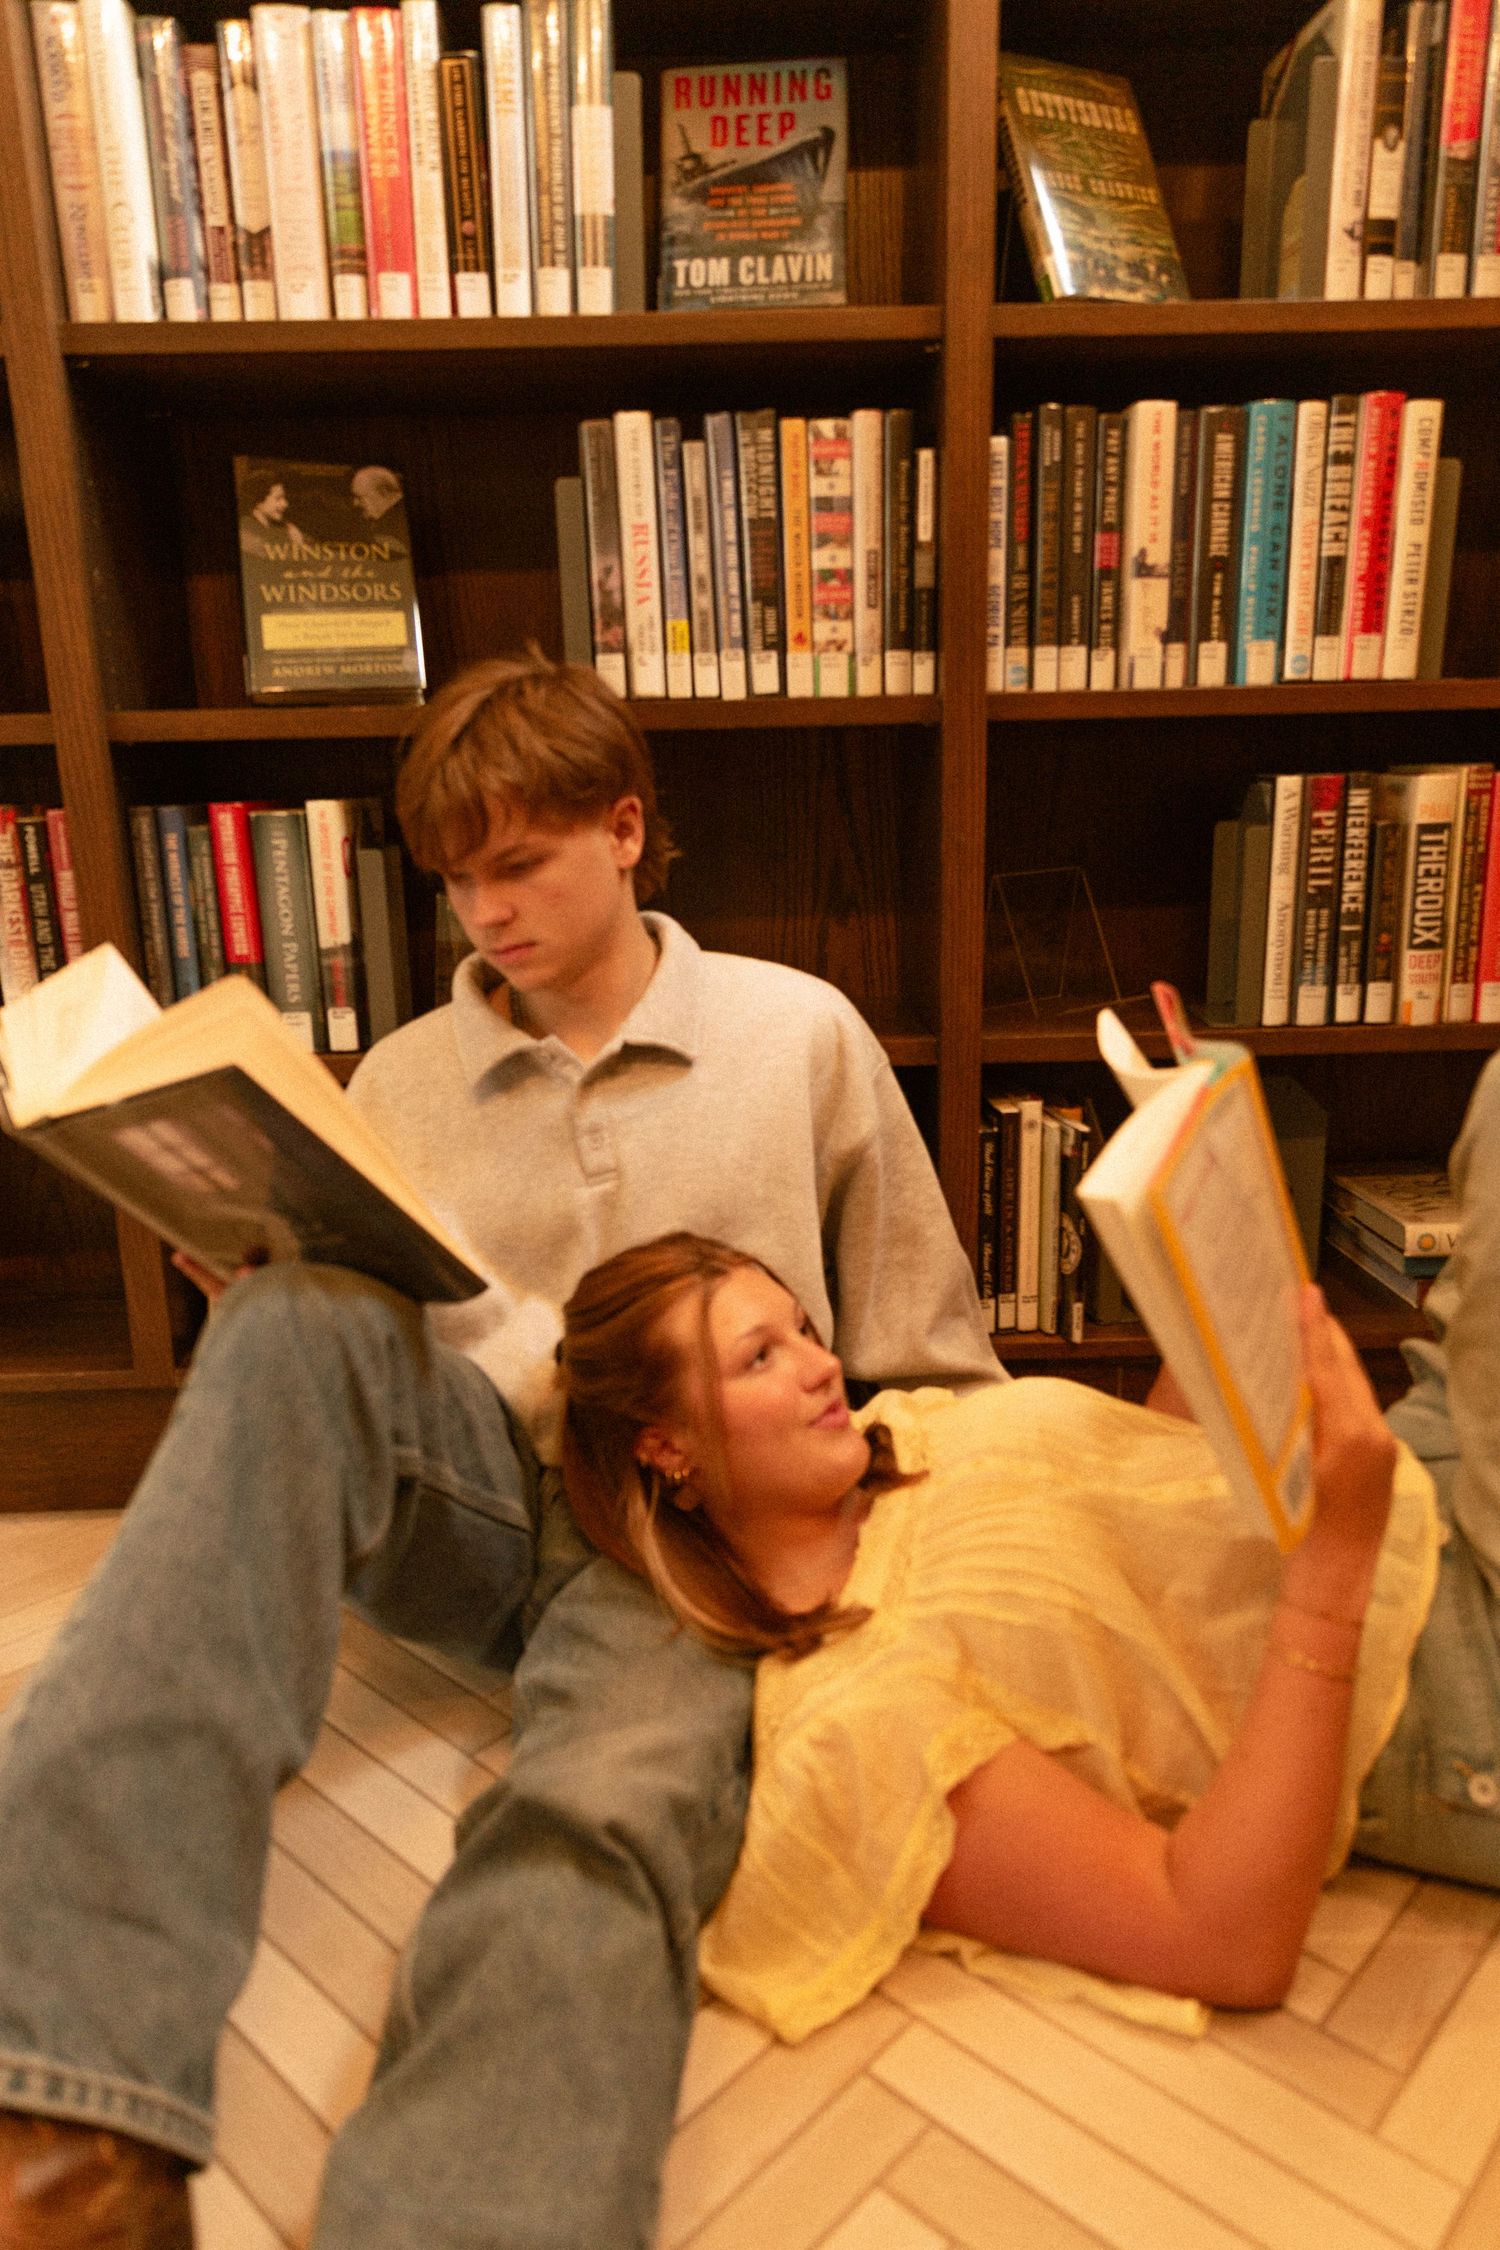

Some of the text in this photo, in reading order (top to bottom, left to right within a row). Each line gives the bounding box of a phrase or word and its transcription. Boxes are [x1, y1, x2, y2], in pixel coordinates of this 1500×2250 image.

[674, 67, 832, 110] RUNNING
[710, 111, 796, 148] DEEP
[672, 253, 833, 288] TOM CLAVIN
[1106, 429, 1120, 453] PAY
[1153, 412, 1162, 437] THE
[1308, 412, 1324, 458] Olivia
[1329, 414, 1356, 455] THE
[757, 428, 776, 518] MIDNIGHT
[1106, 458, 1119, 482] ANY
[1150, 442, 1160, 488] WORLD
[1272, 435, 1288, 512] ALONE
[1410, 417, 1434, 526] COMPROMISED
[1103, 486, 1119, 524] PRICE
[1150, 495, 1159, 510] AS
[1209, 432, 1235, 558] AMERICAN CARNAGE
[1302, 466, 1321, 508] Nuzzi
[1321, 465, 1353, 557] BREACH
[263, 541, 391, 562] WINSTON
[988, 521, 1001, 550] HOPE
[1270, 525, 1283, 571] CAN
[283, 564, 378, 579] and the
[630, 523, 653, 606] RUSSIA
[1403, 544, 1422, 585] PETER
[259, 581, 402, 603] WINDSORS
[1266, 583, 1279, 619] FIX
[1277, 806, 1297, 876] Warning
[1307, 810, 1338, 894] PERIL
[1340, 788, 1371, 914] INTERFERENCE
[1, 869, 26, 944] DARKEST
[25, 825, 57, 969] POWELL UTAH AND THE
[1412, 829, 1450, 947] THEROUX
[270, 838, 302, 1003] PENTAGON PAPERS
[1408, 953, 1442, 970] DEEP
